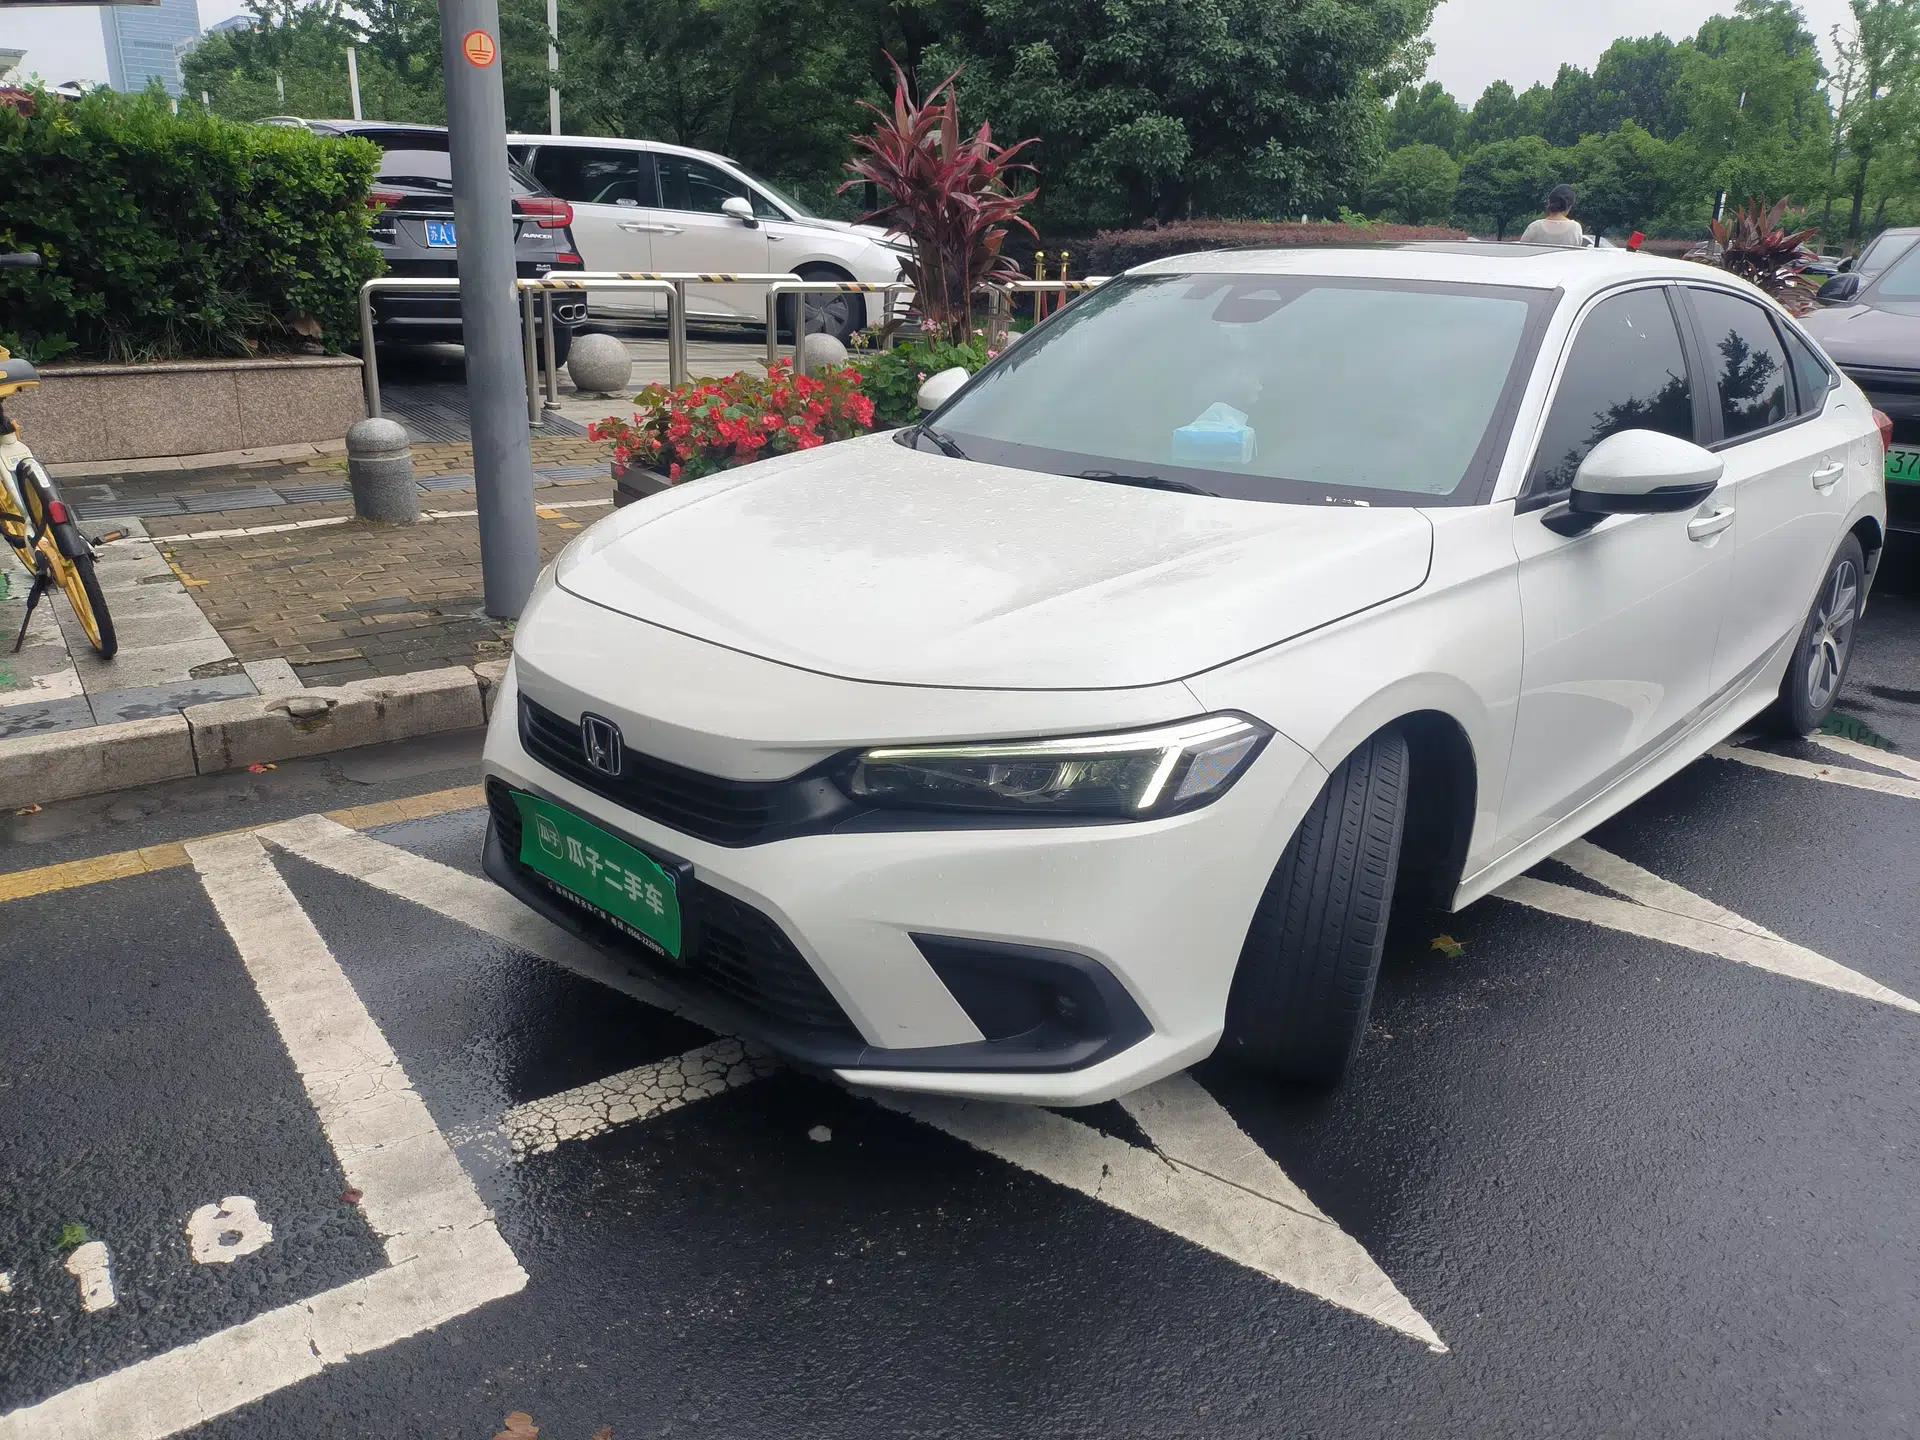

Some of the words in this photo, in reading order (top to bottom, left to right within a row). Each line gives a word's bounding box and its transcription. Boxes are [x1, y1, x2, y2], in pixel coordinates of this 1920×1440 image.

[429, 223, 456, 244] 苏A
[1885, 450, 1920, 475] 37
[566, 835, 664, 915] 瓜子二手车
